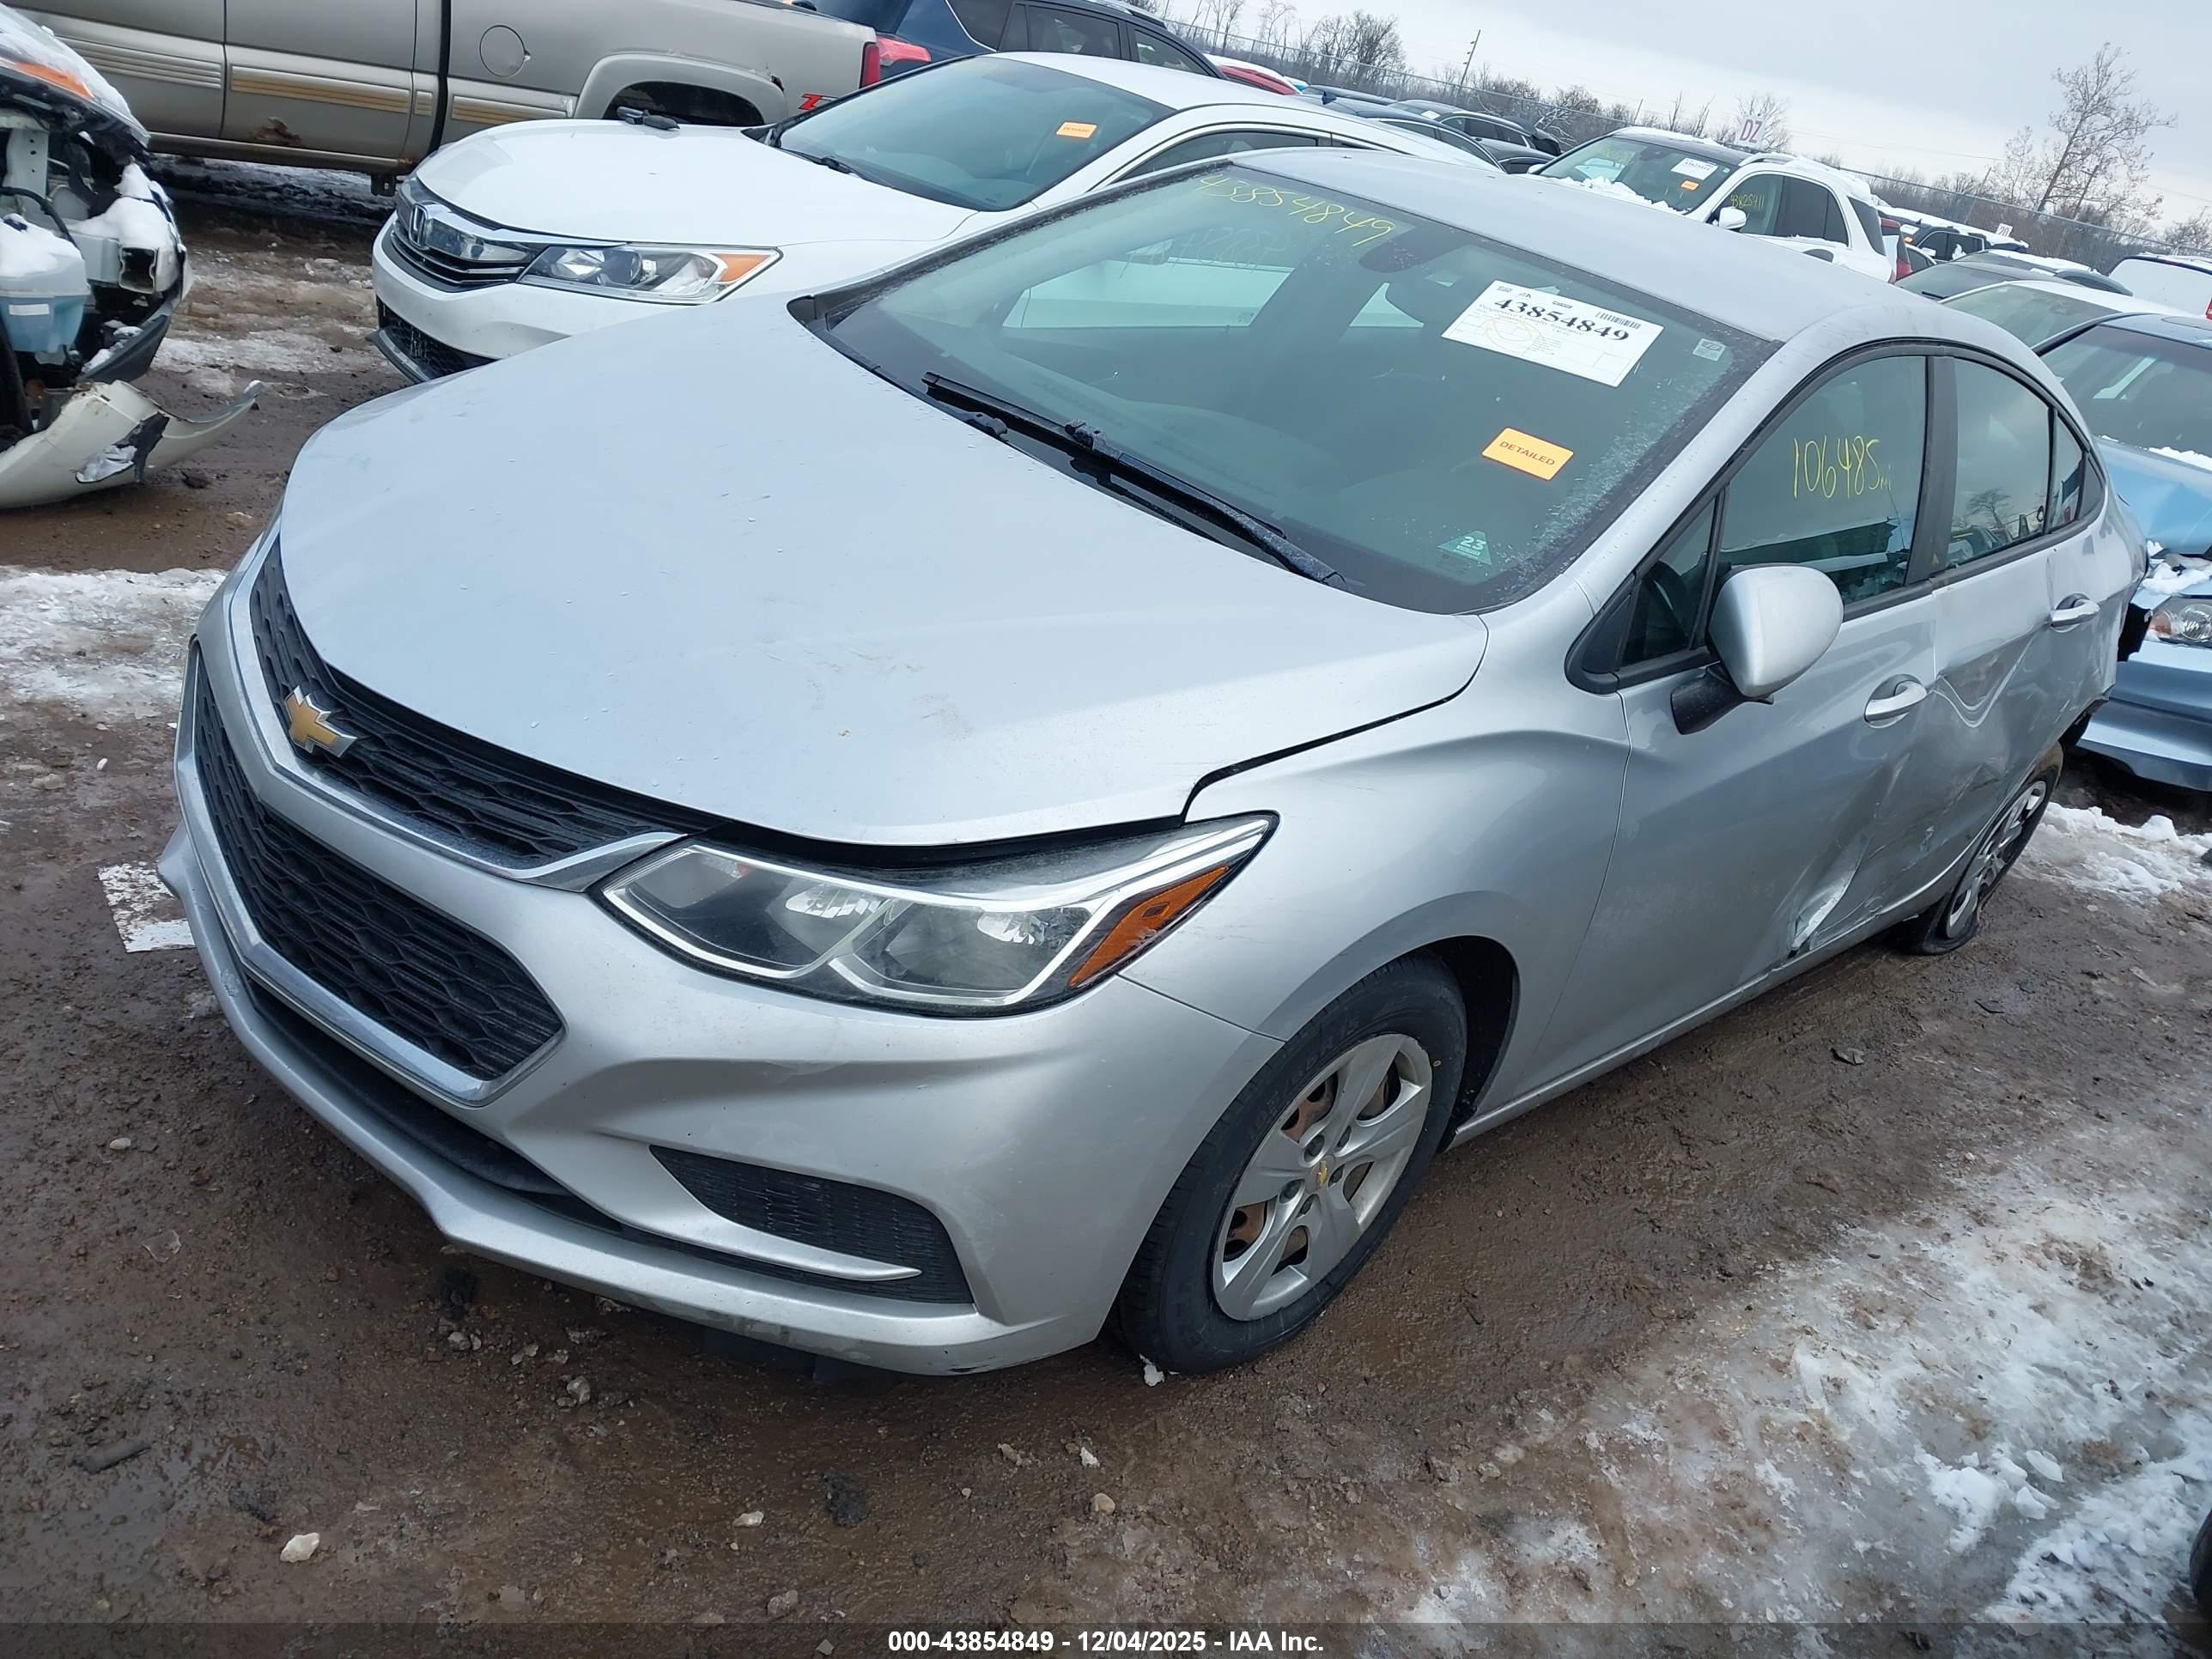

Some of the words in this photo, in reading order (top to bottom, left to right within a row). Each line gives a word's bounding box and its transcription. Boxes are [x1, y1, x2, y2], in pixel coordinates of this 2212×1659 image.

[1194, 174, 1396, 246] 43854849
[1494, 299, 1630, 341] 43854849
[1499, 441, 1555, 465] DETAILED
[1461, 536, 1486, 550] 23
